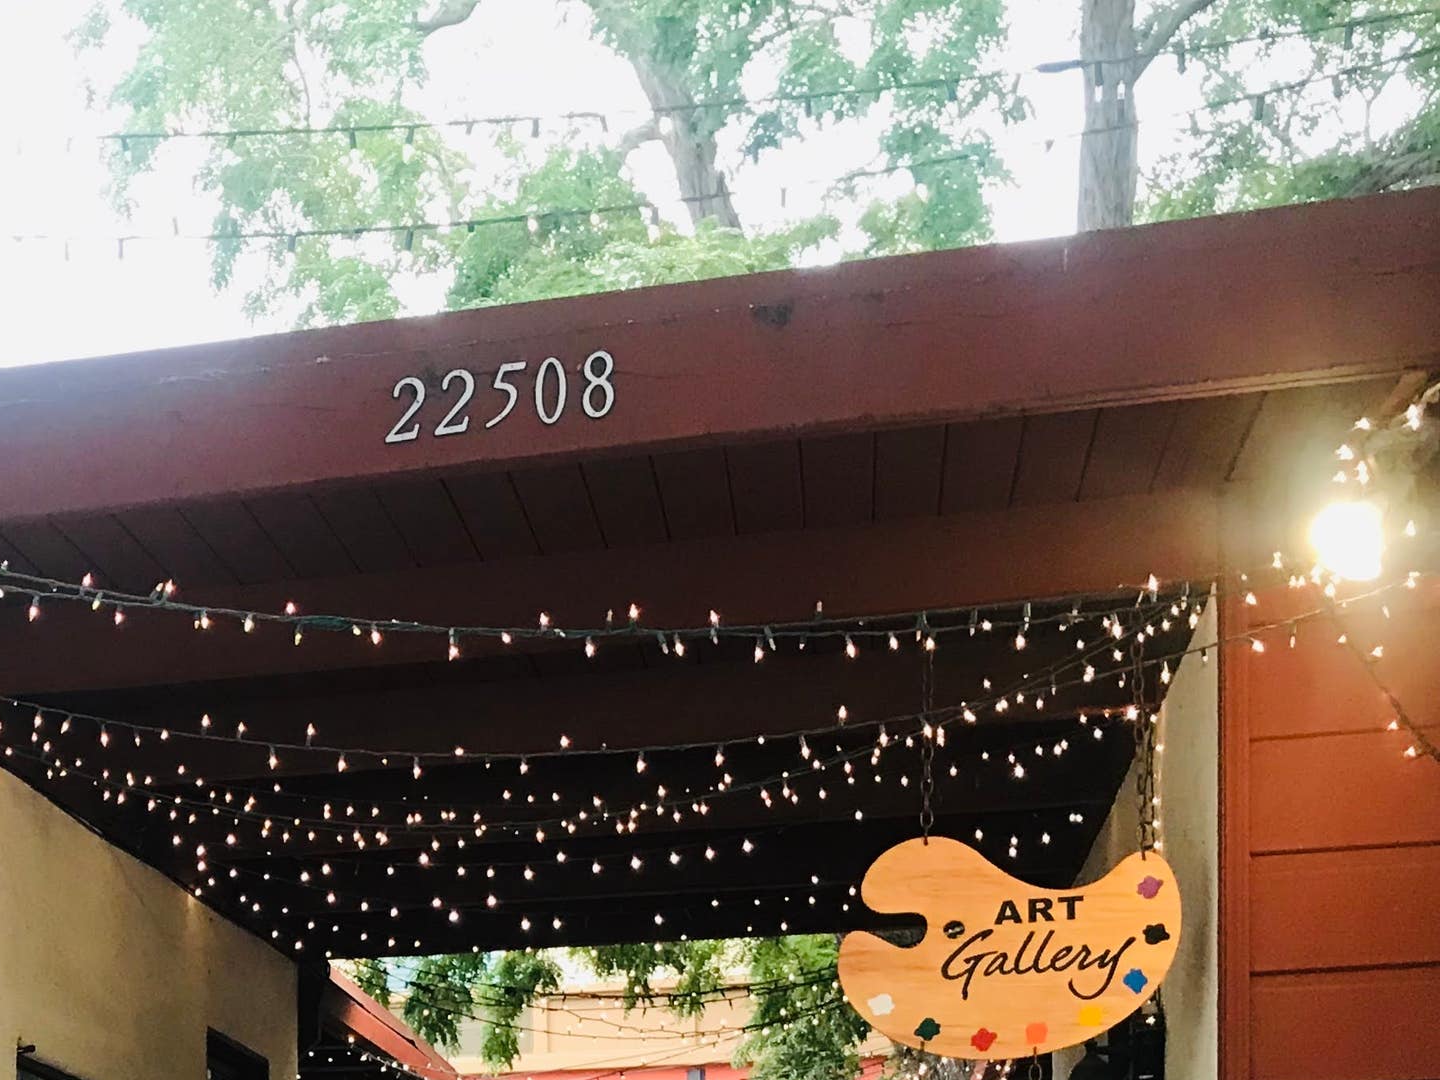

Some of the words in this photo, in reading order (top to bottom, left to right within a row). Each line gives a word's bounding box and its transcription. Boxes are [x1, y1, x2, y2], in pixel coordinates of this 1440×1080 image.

[385, 350, 615, 443] 22508
[994, 895, 1085, 926] ART
[940, 929, 1137, 1001] Gallery
